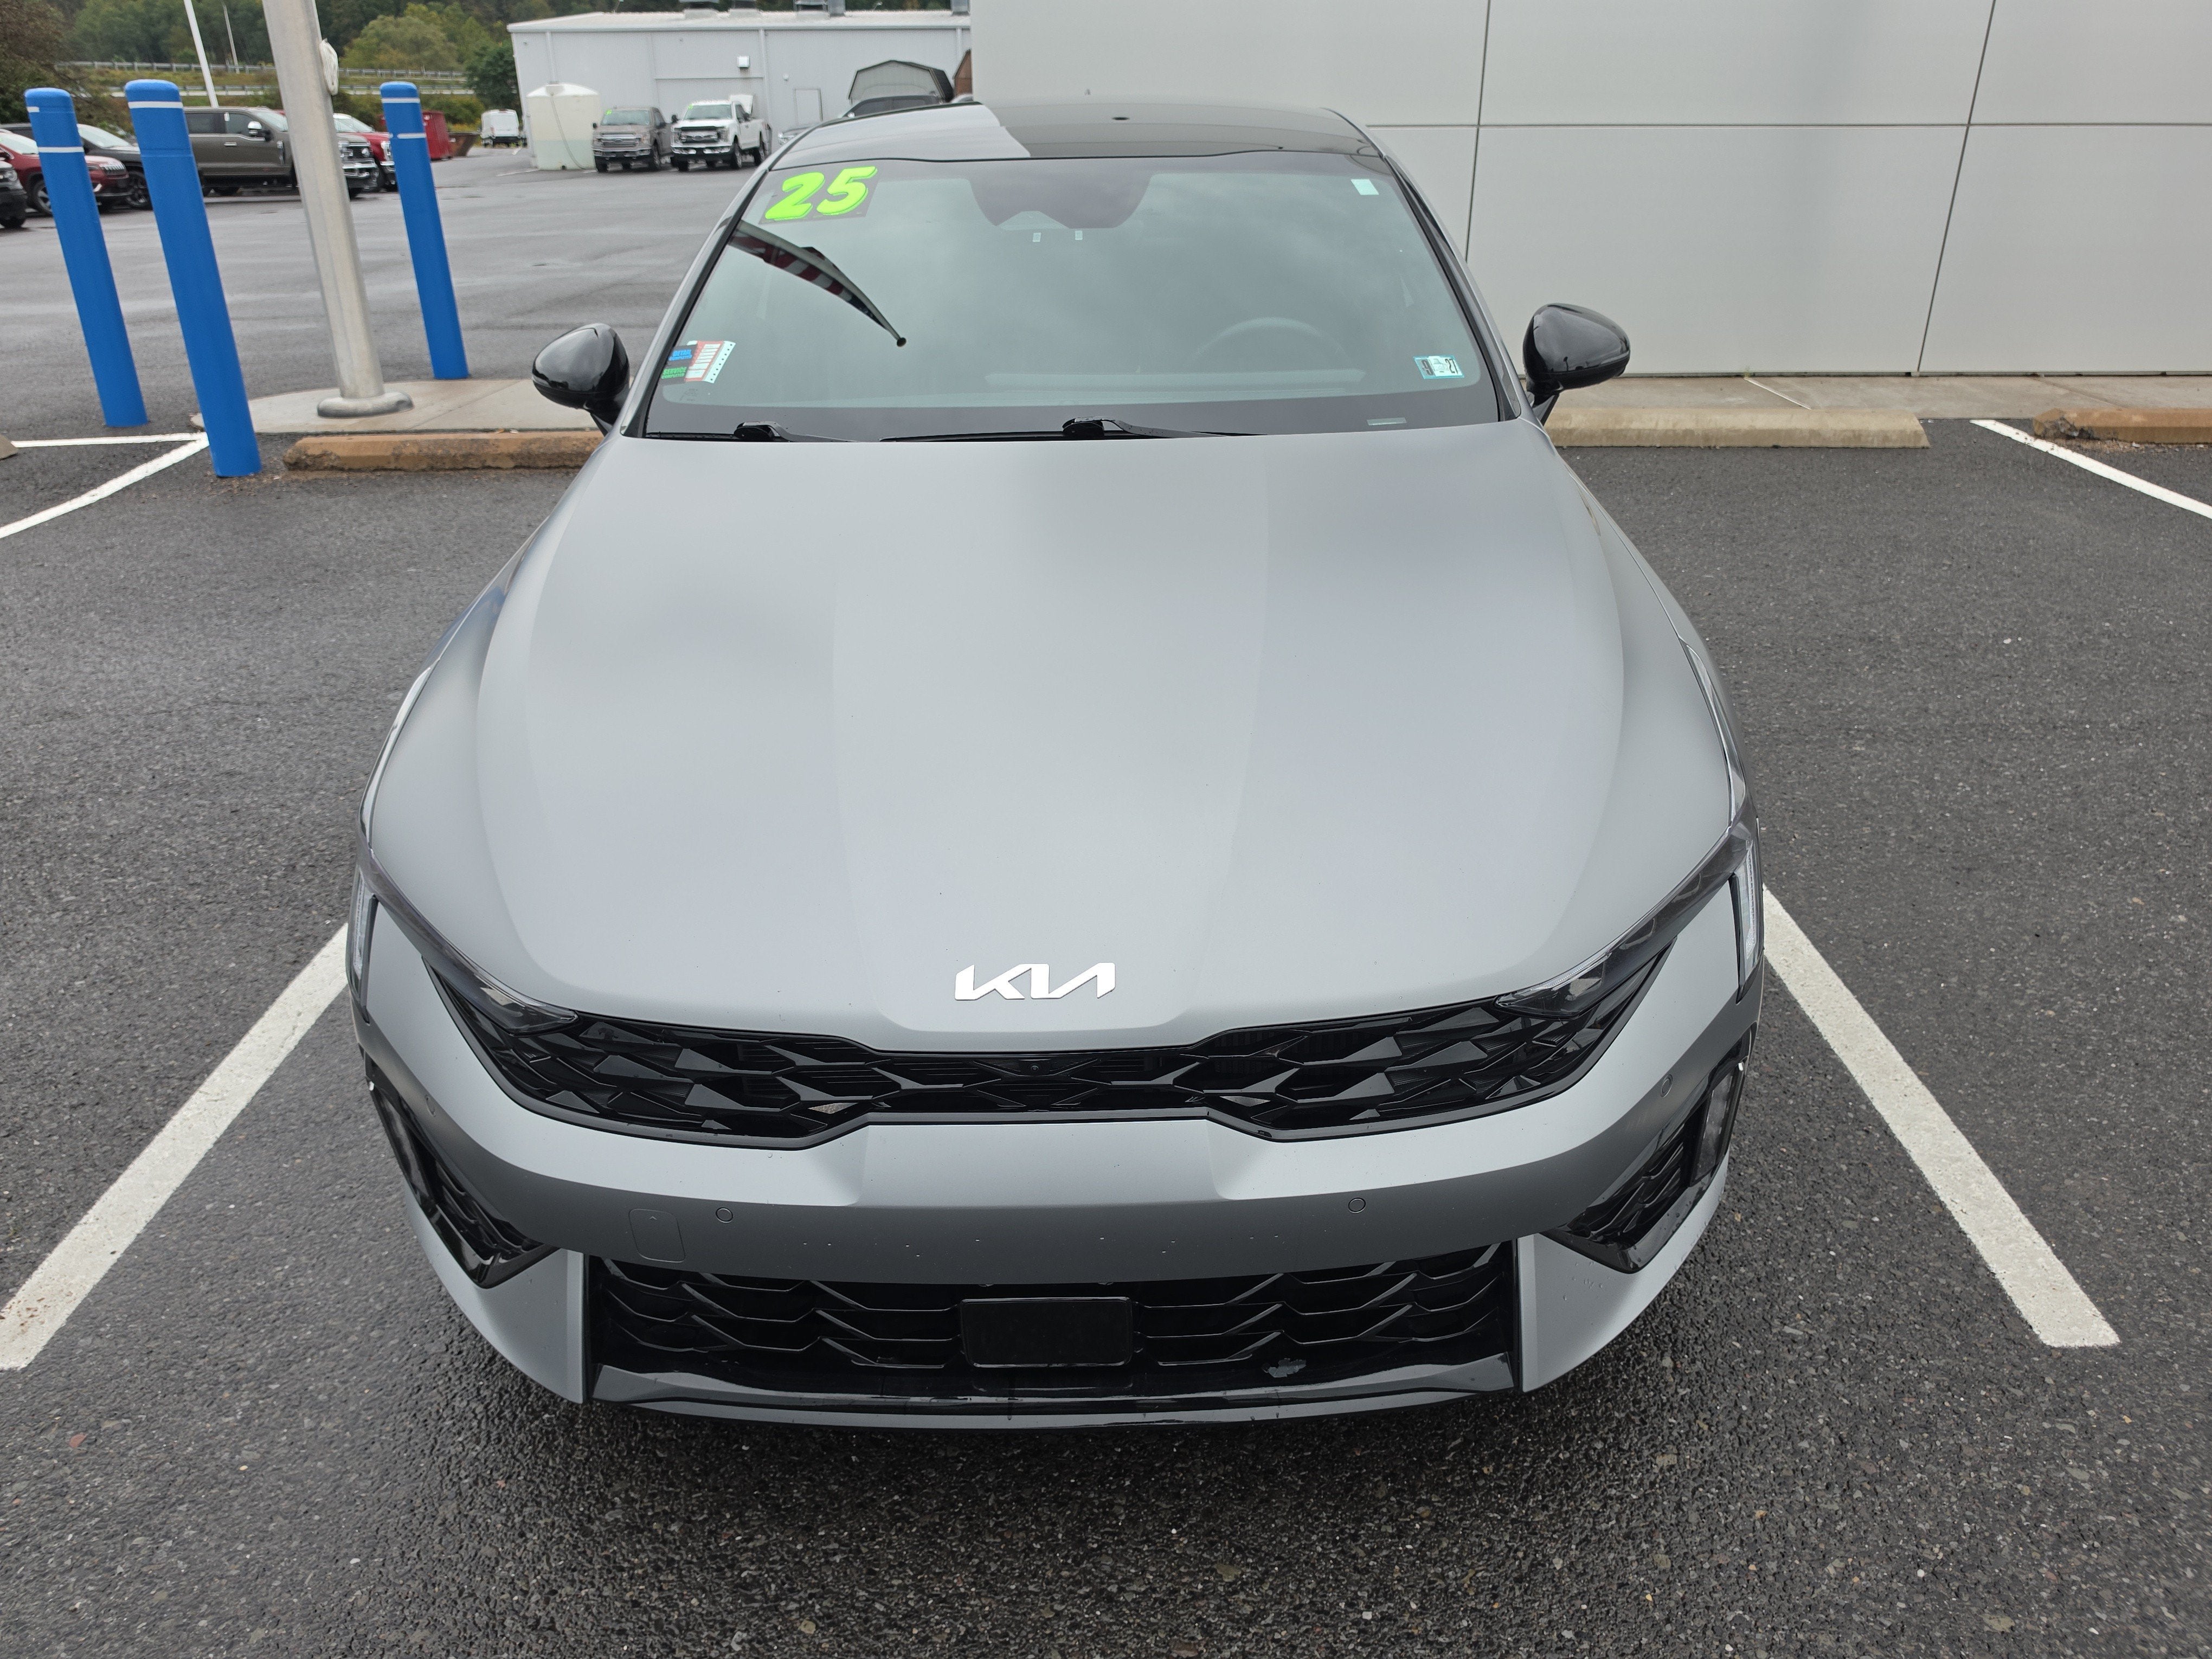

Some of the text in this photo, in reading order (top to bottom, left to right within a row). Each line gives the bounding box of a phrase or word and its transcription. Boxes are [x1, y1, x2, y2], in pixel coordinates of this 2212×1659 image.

[765, 166, 878, 221] 25
[1444, 358, 1458, 375] 27
[955, 962, 1116, 1000] KIA
